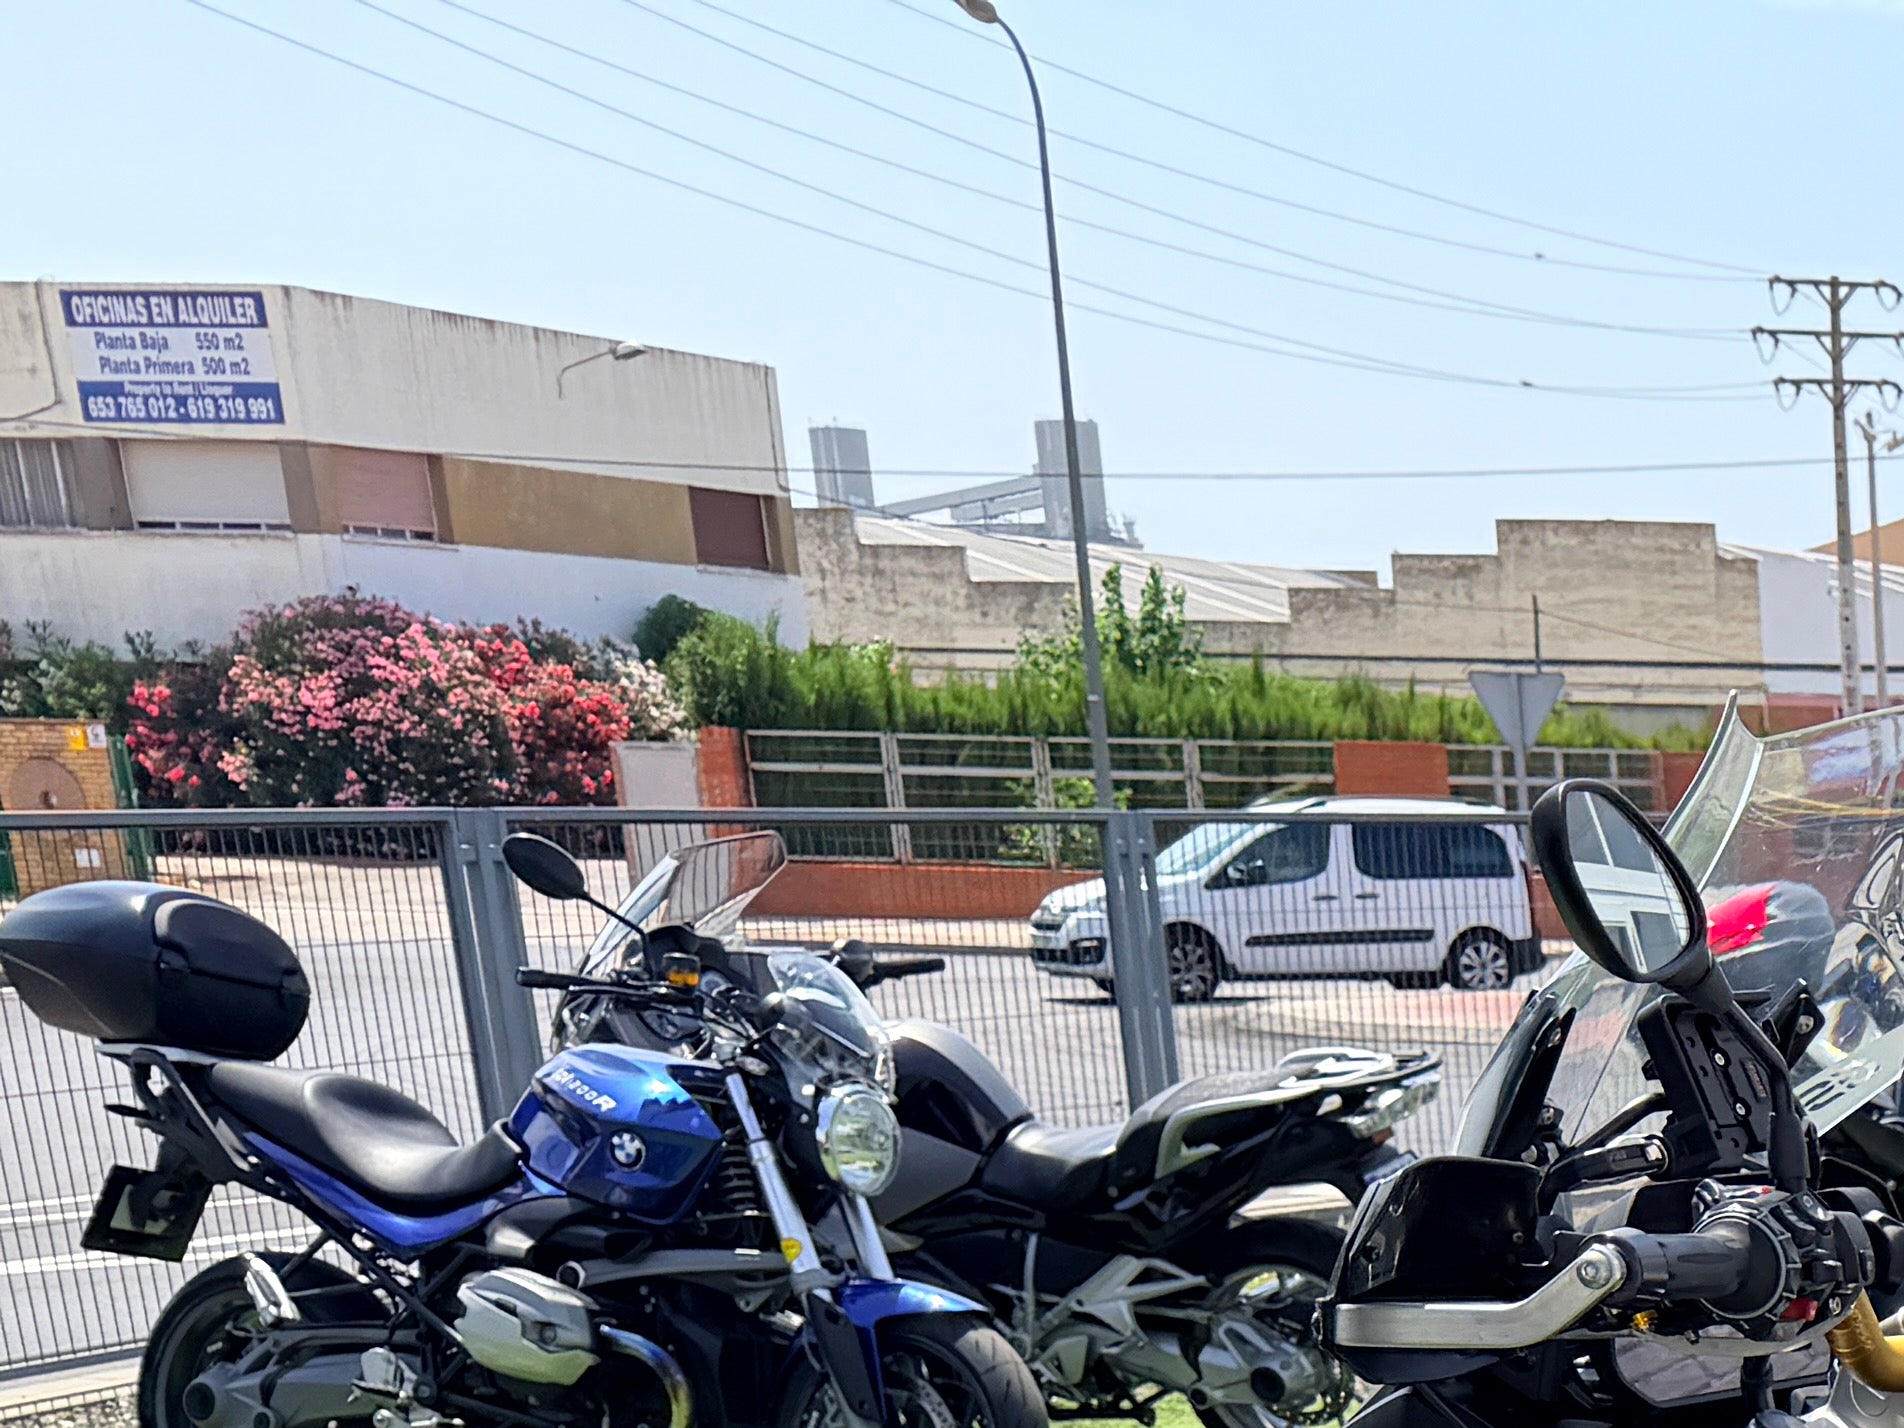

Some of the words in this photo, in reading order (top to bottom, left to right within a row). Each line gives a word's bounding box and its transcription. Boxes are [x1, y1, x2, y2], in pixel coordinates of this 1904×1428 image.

[71, 296, 148, 324] OFICINAS
[150, 296, 176, 324] EN
[178, 296, 260, 325] ALQUILER
[94, 331, 136, 350] Planta
[139, 331, 169, 353] Baja
[195, 333, 219, 351] 550
[224, 333, 244, 351] m2
[99, 356, 141, 375] Planta
[144, 356, 195, 375] Primera
[201, 357, 226, 376] 500
[230, 357, 250, 375] m2
[88, 396, 115, 418] 653
[117, 396, 146, 419] 765
[148, 397, 178, 419] 012
[187, 397, 216, 419] 619
[218, 397, 246, 419] 319
[248, 398, 276, 420] 991
